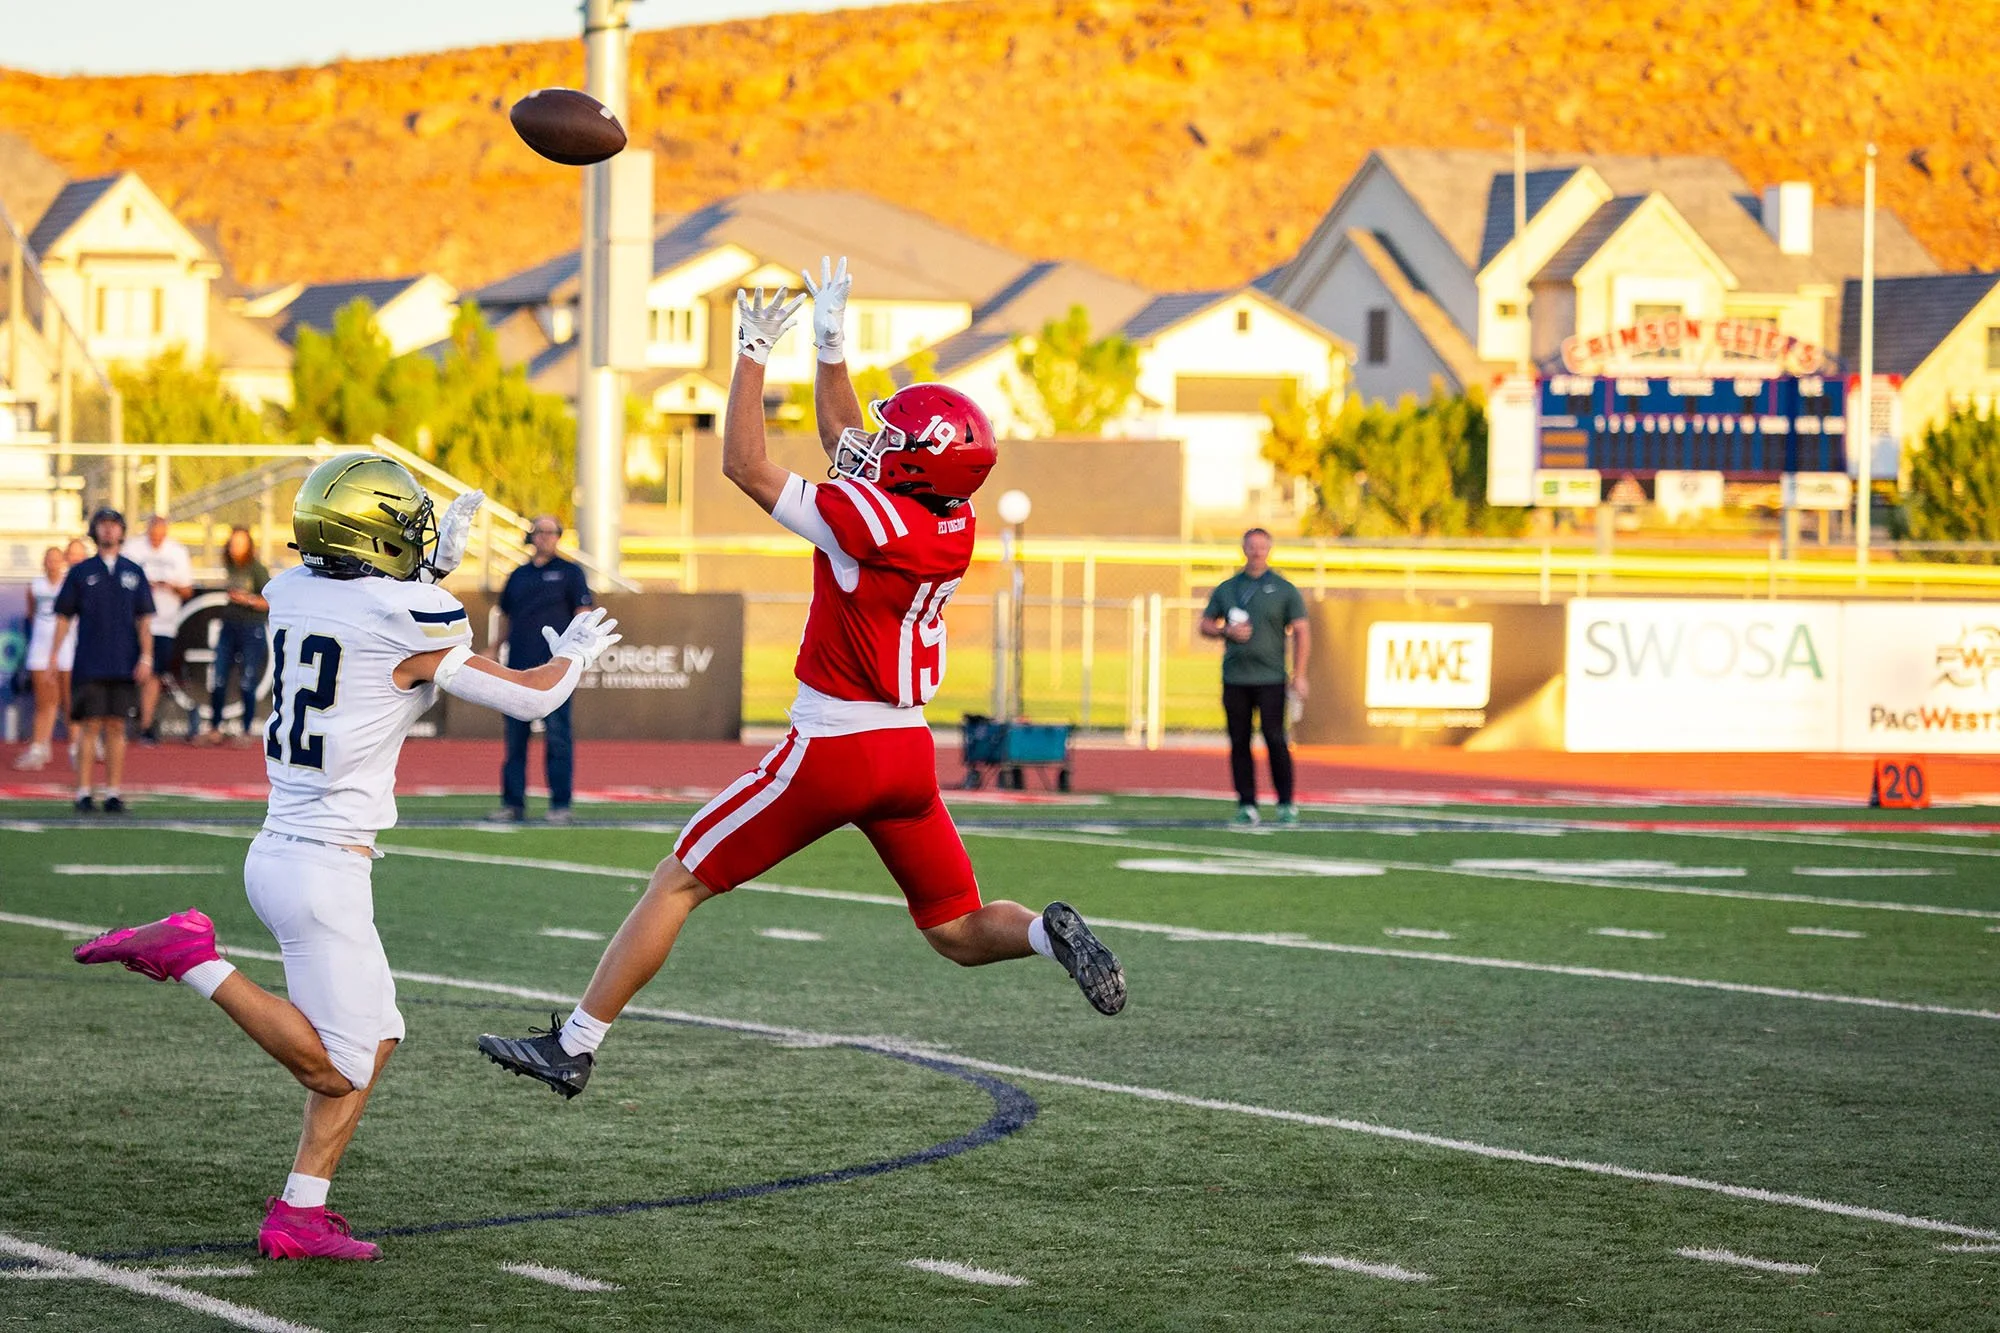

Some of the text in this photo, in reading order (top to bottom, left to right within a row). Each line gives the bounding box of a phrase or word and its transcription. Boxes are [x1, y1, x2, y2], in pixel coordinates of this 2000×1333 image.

[916, 414, 957, 456] 19
[589, 644, 715, 673] ORGE IV
[898, 577, 962, 707] 19
[1385, 639, 1474, 684] MAKE
[1584, 620, 1824, 679] SWOSA
[265, 626, 344, 774] 12
[1883, 764, 1924, 800] 20
